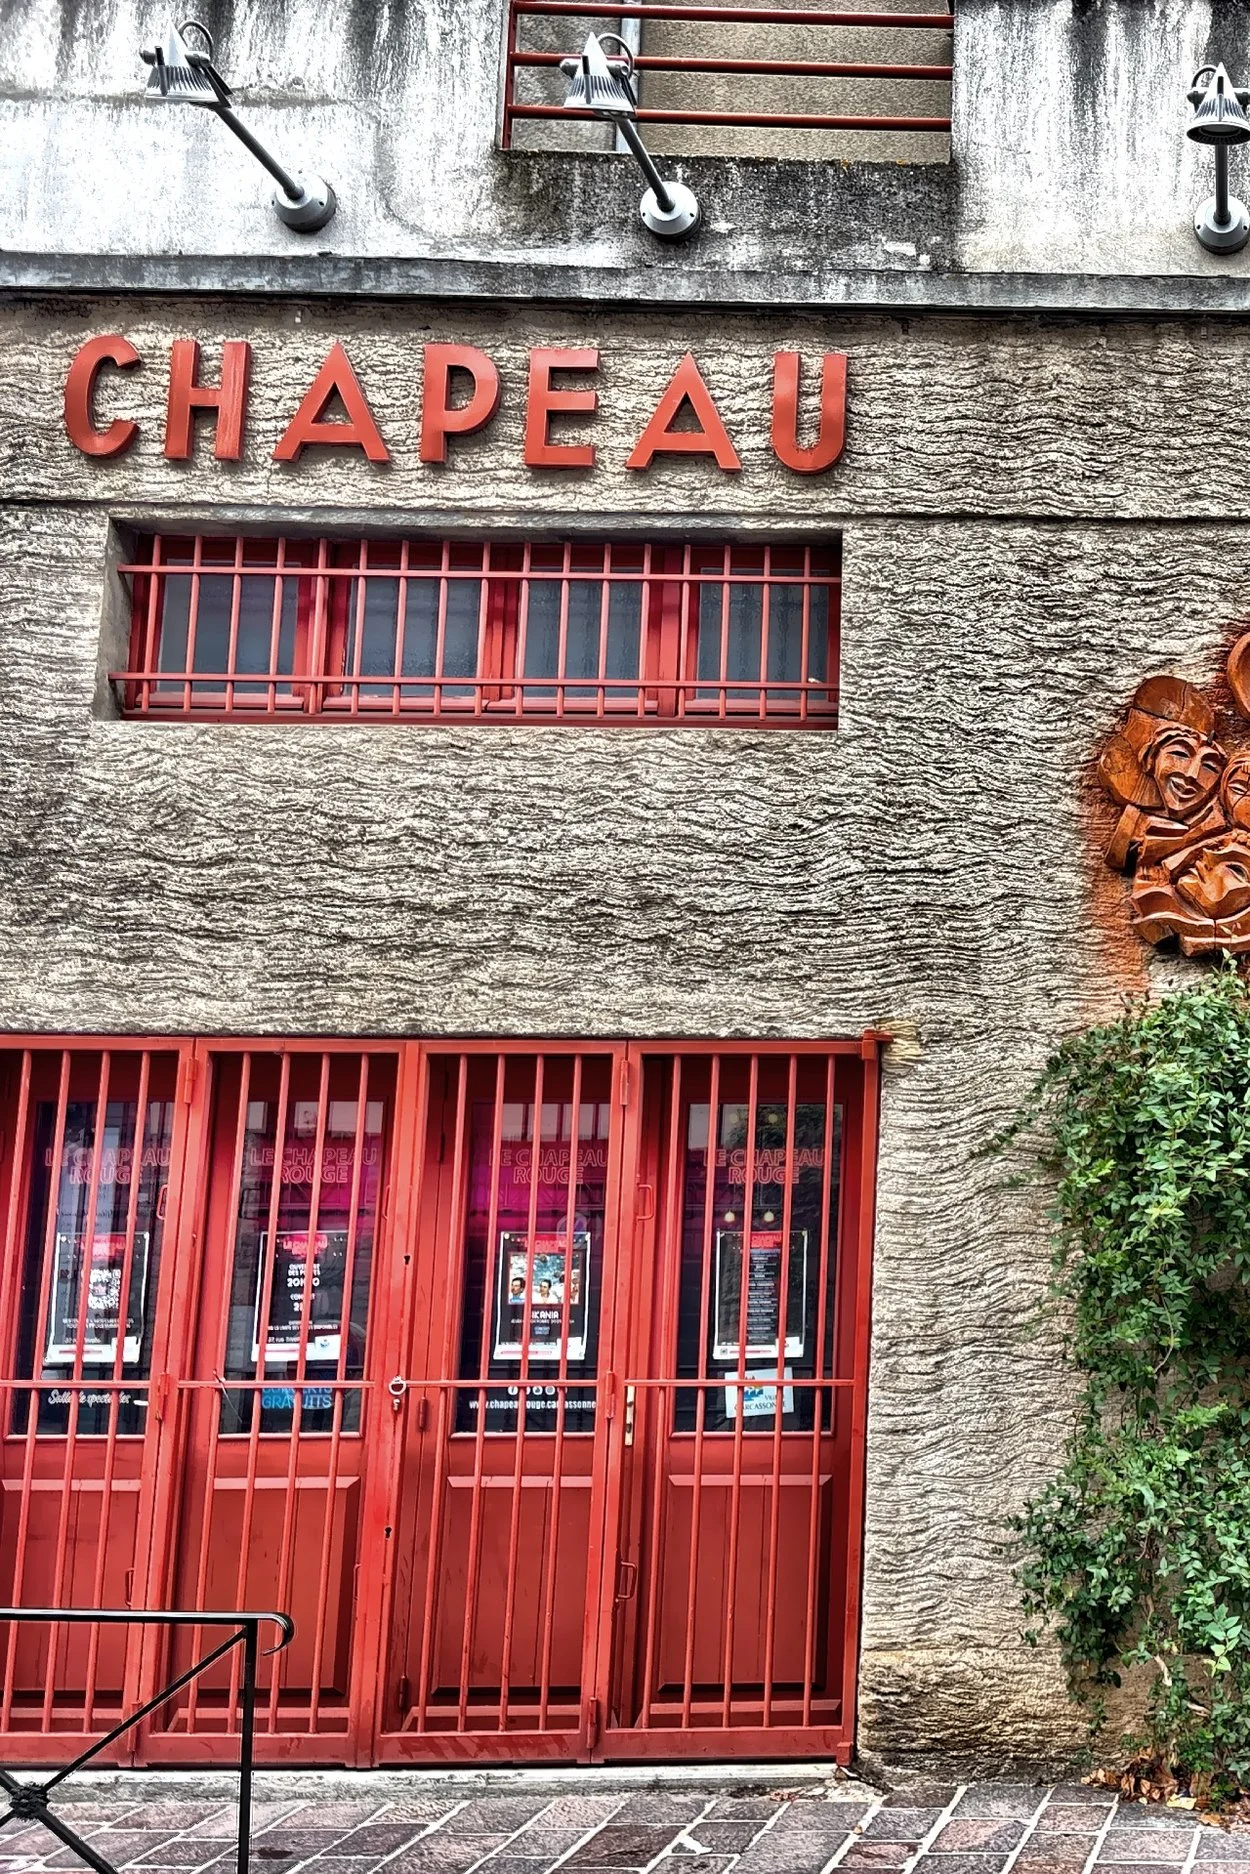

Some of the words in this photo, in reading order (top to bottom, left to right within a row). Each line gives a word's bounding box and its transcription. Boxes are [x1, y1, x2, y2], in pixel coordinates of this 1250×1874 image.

[63, 335, 848, 475] CHAPEAU
[73, 1147, 170, 1167] CHAPAU
[250, 1147, 274, 1166] LE
[69, 1166, 143, 1184] ROUG
[513, 1166, 584, 1184] ROUGE
[728, 1166, 800, 1184] ROUGE
[287, 1277, 320, 1288] 20H0
[48, 1389, 72, 1404] Sall
[87, 1391, 131, 1408] spectles
[262, 1395, 334, 1409] GRAUITS
[734, 1401, 787, 1411] RCASSONE
